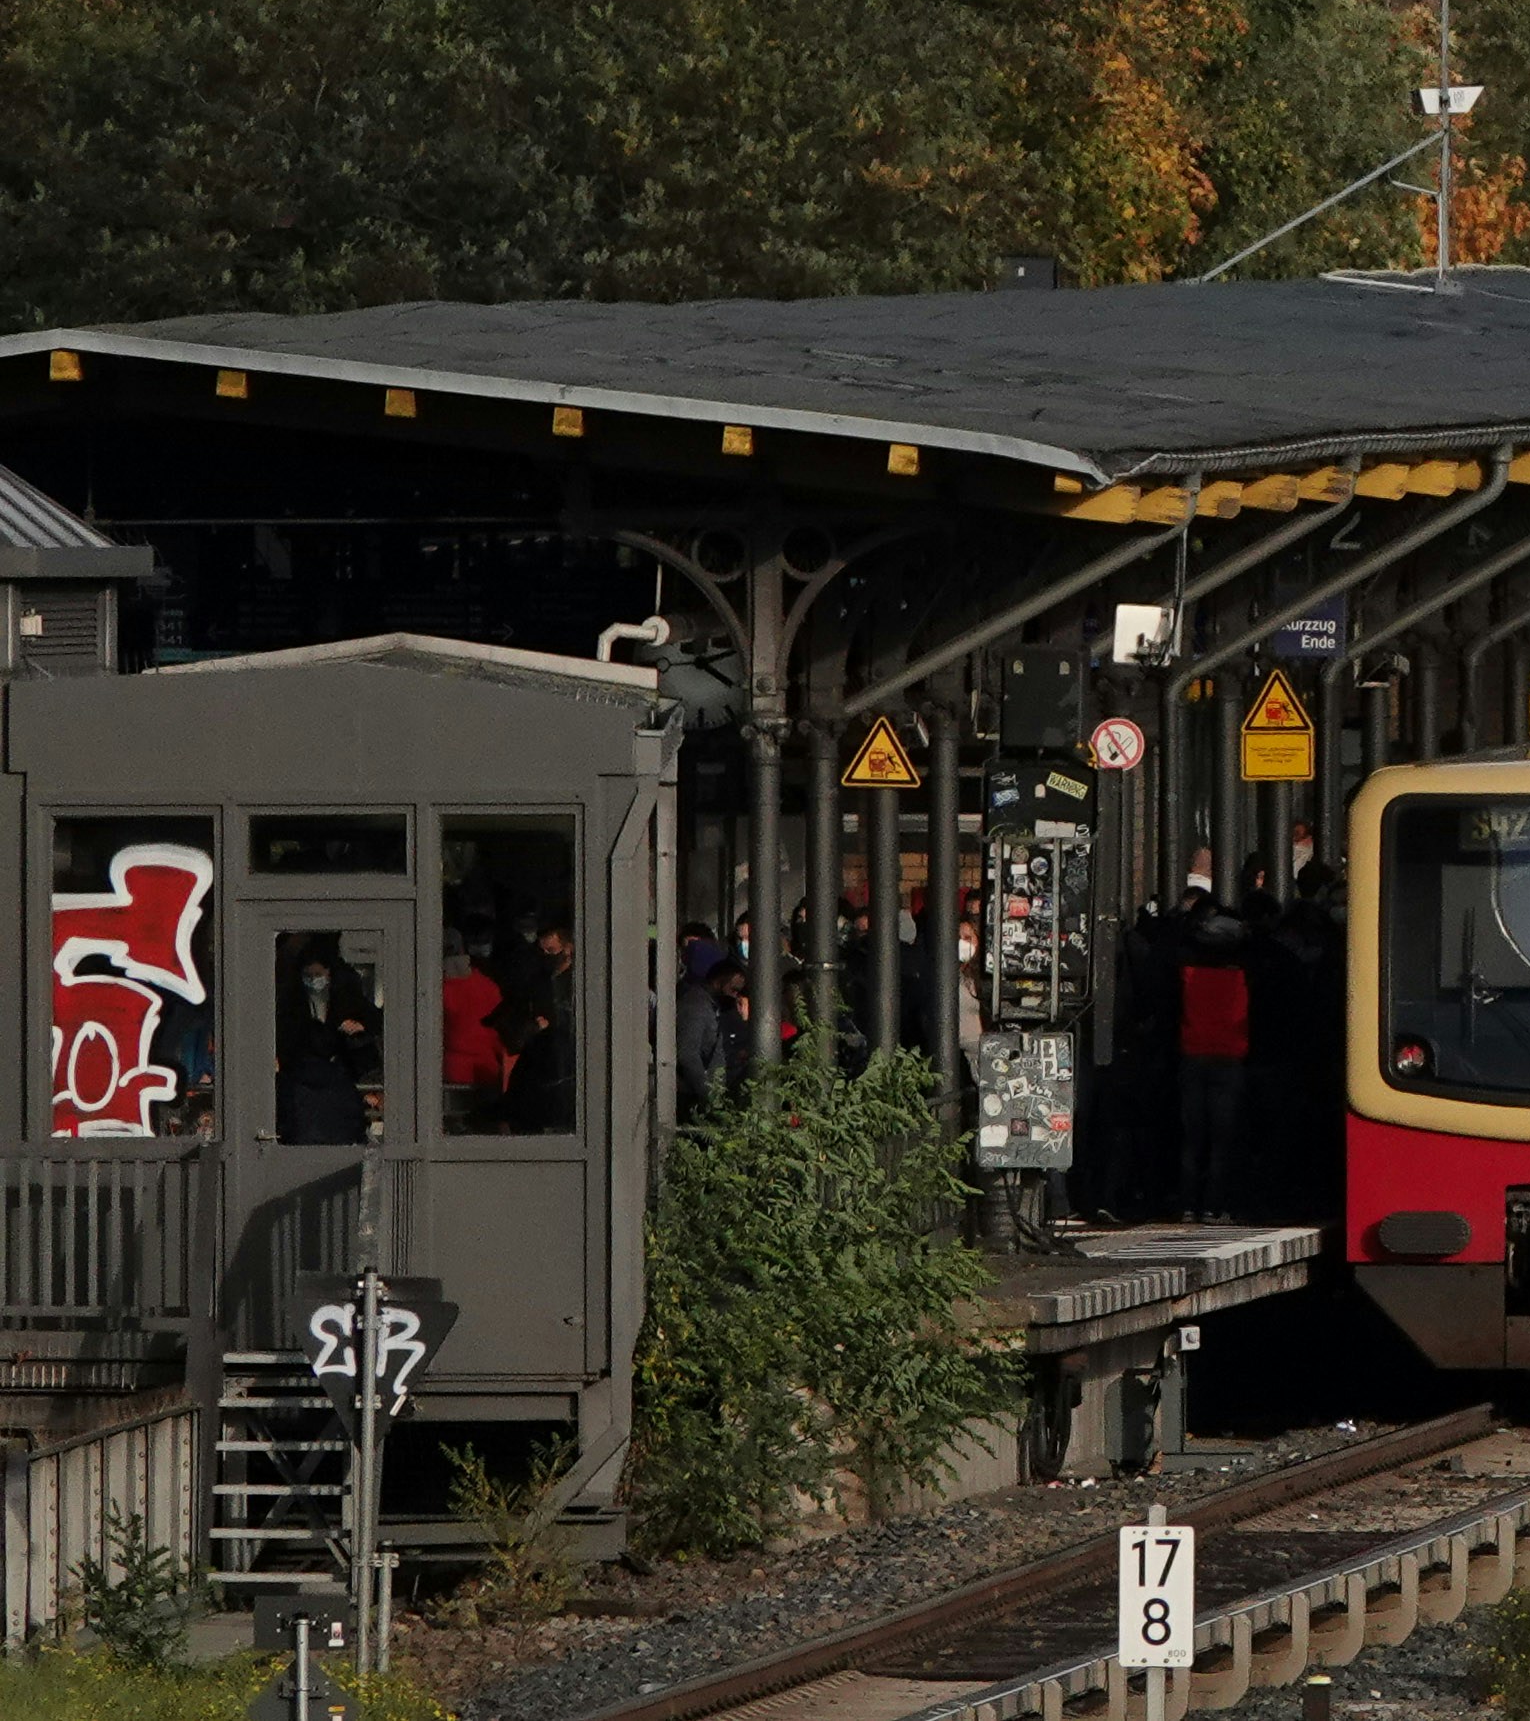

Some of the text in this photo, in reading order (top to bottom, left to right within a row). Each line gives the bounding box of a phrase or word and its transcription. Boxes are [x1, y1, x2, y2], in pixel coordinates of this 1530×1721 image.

[1281, 620, 1337, 634] urzzug
[1301, 635, 1337, 649] Ende
[1132, 1539, 1181, 1587] 17
[1141, 1598, 1171, 1646] 8
